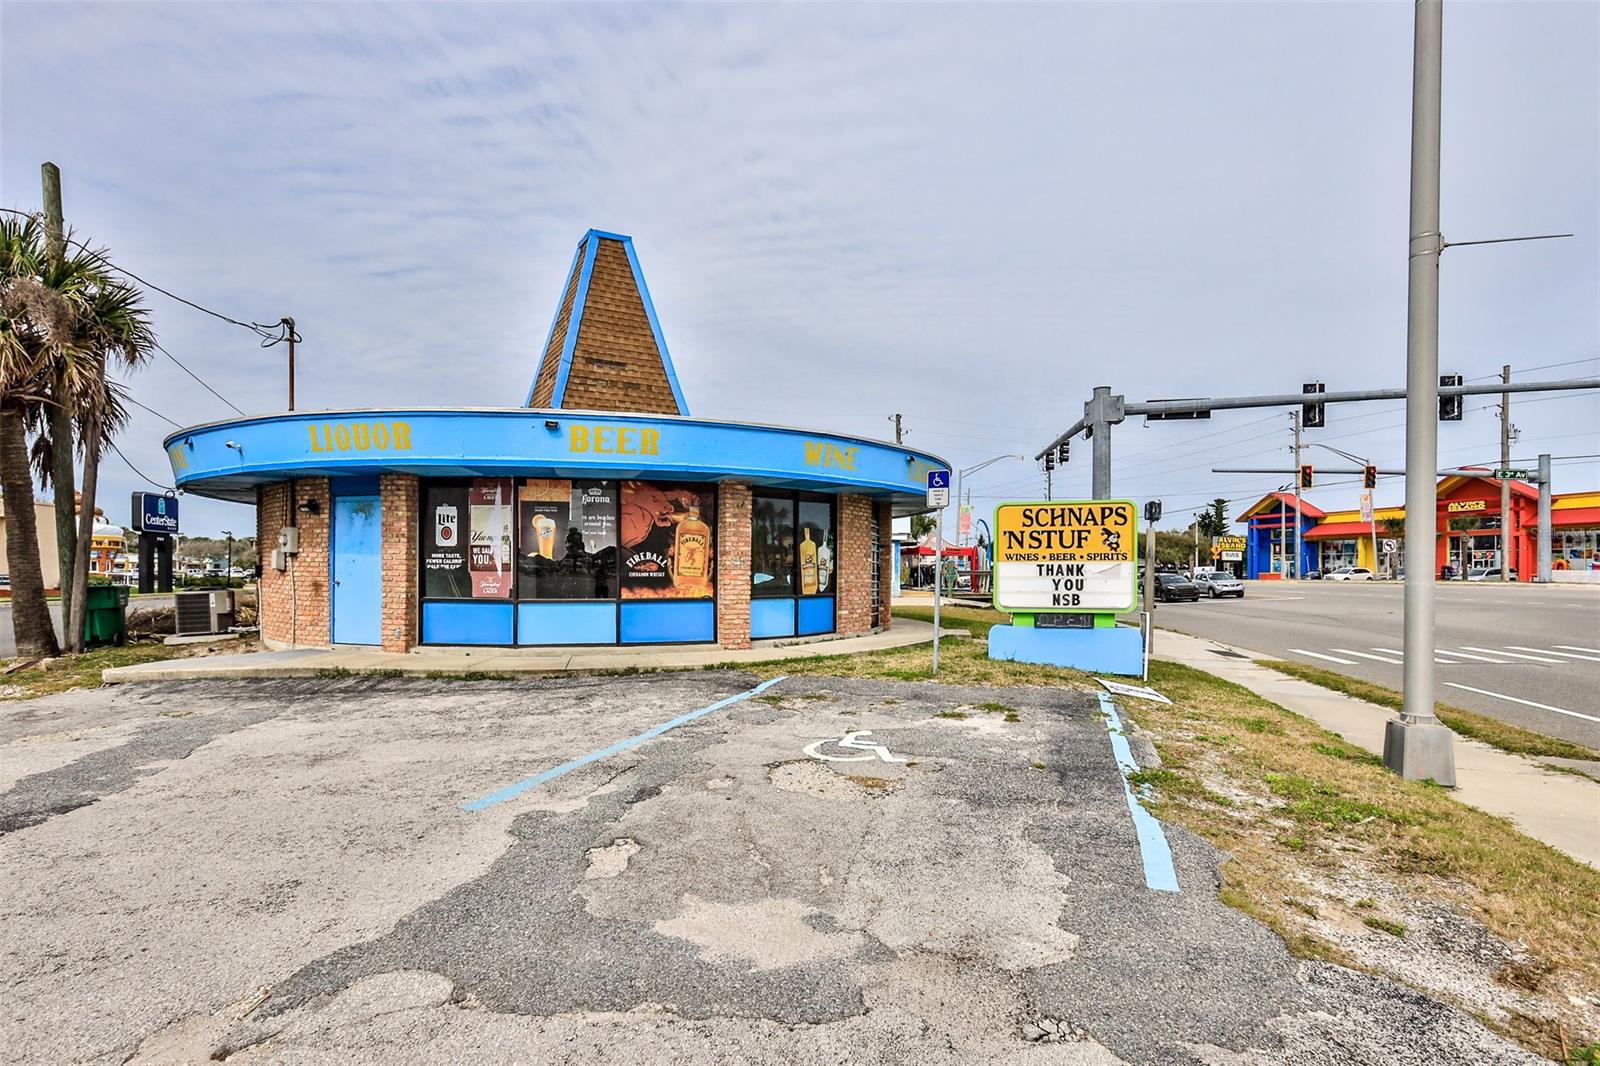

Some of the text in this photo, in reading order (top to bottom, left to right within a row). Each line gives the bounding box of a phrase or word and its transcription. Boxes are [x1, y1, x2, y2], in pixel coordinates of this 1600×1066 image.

[309, 422, 412, 452] LIQUOR
[569, 424, 660, 456] BEER
[805, 440, 860, 472] WINE
[582, 494, 610, 505] Corona
[145, 513, 177, 527] CenterState
[438, 513, 456, 525] Lite
[1022, 506, 1128, 527] SCHNAPS
[681, 537, 704, 546] FIREBALL
[1028, 529, 1091, 549] STUF
[473, 554, 492, 565] YOU.
[625, 551, 668, 568] FIREBALL
[1005, 552, 1128, 561] WINES BEER SPIRITS
[1037, 564, 1085, 577] THANK
[1052, 579, 1084, 591] YOU
[1052, 594, 1081, 606] NSB
